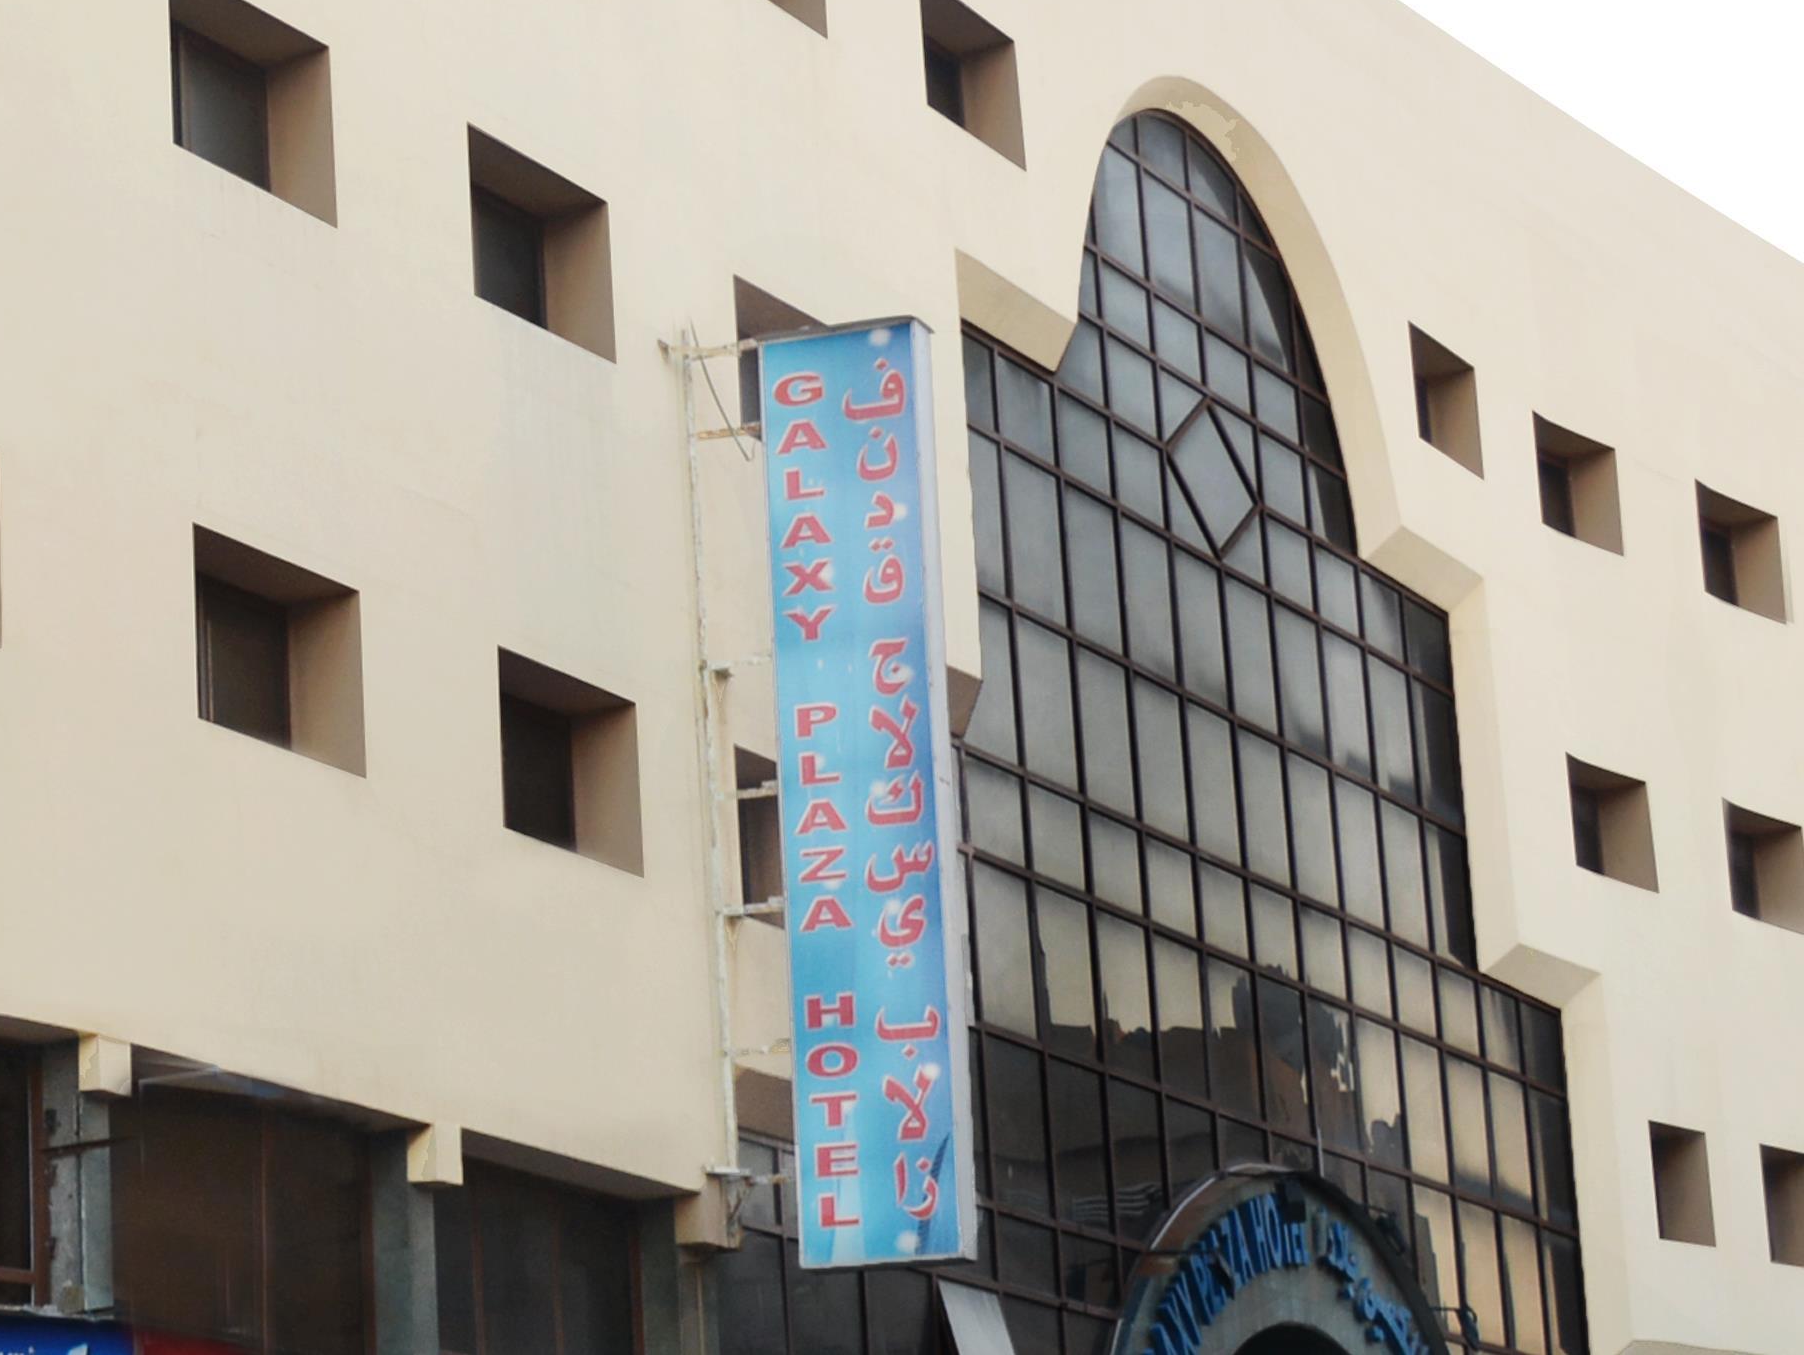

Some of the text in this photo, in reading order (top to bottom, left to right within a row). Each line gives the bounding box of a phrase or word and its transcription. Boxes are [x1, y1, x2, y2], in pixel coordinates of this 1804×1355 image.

[842, 357, 906, 604] فندق
[773, 372, 860, 1229] GALAXY PLAZA HOTEL
